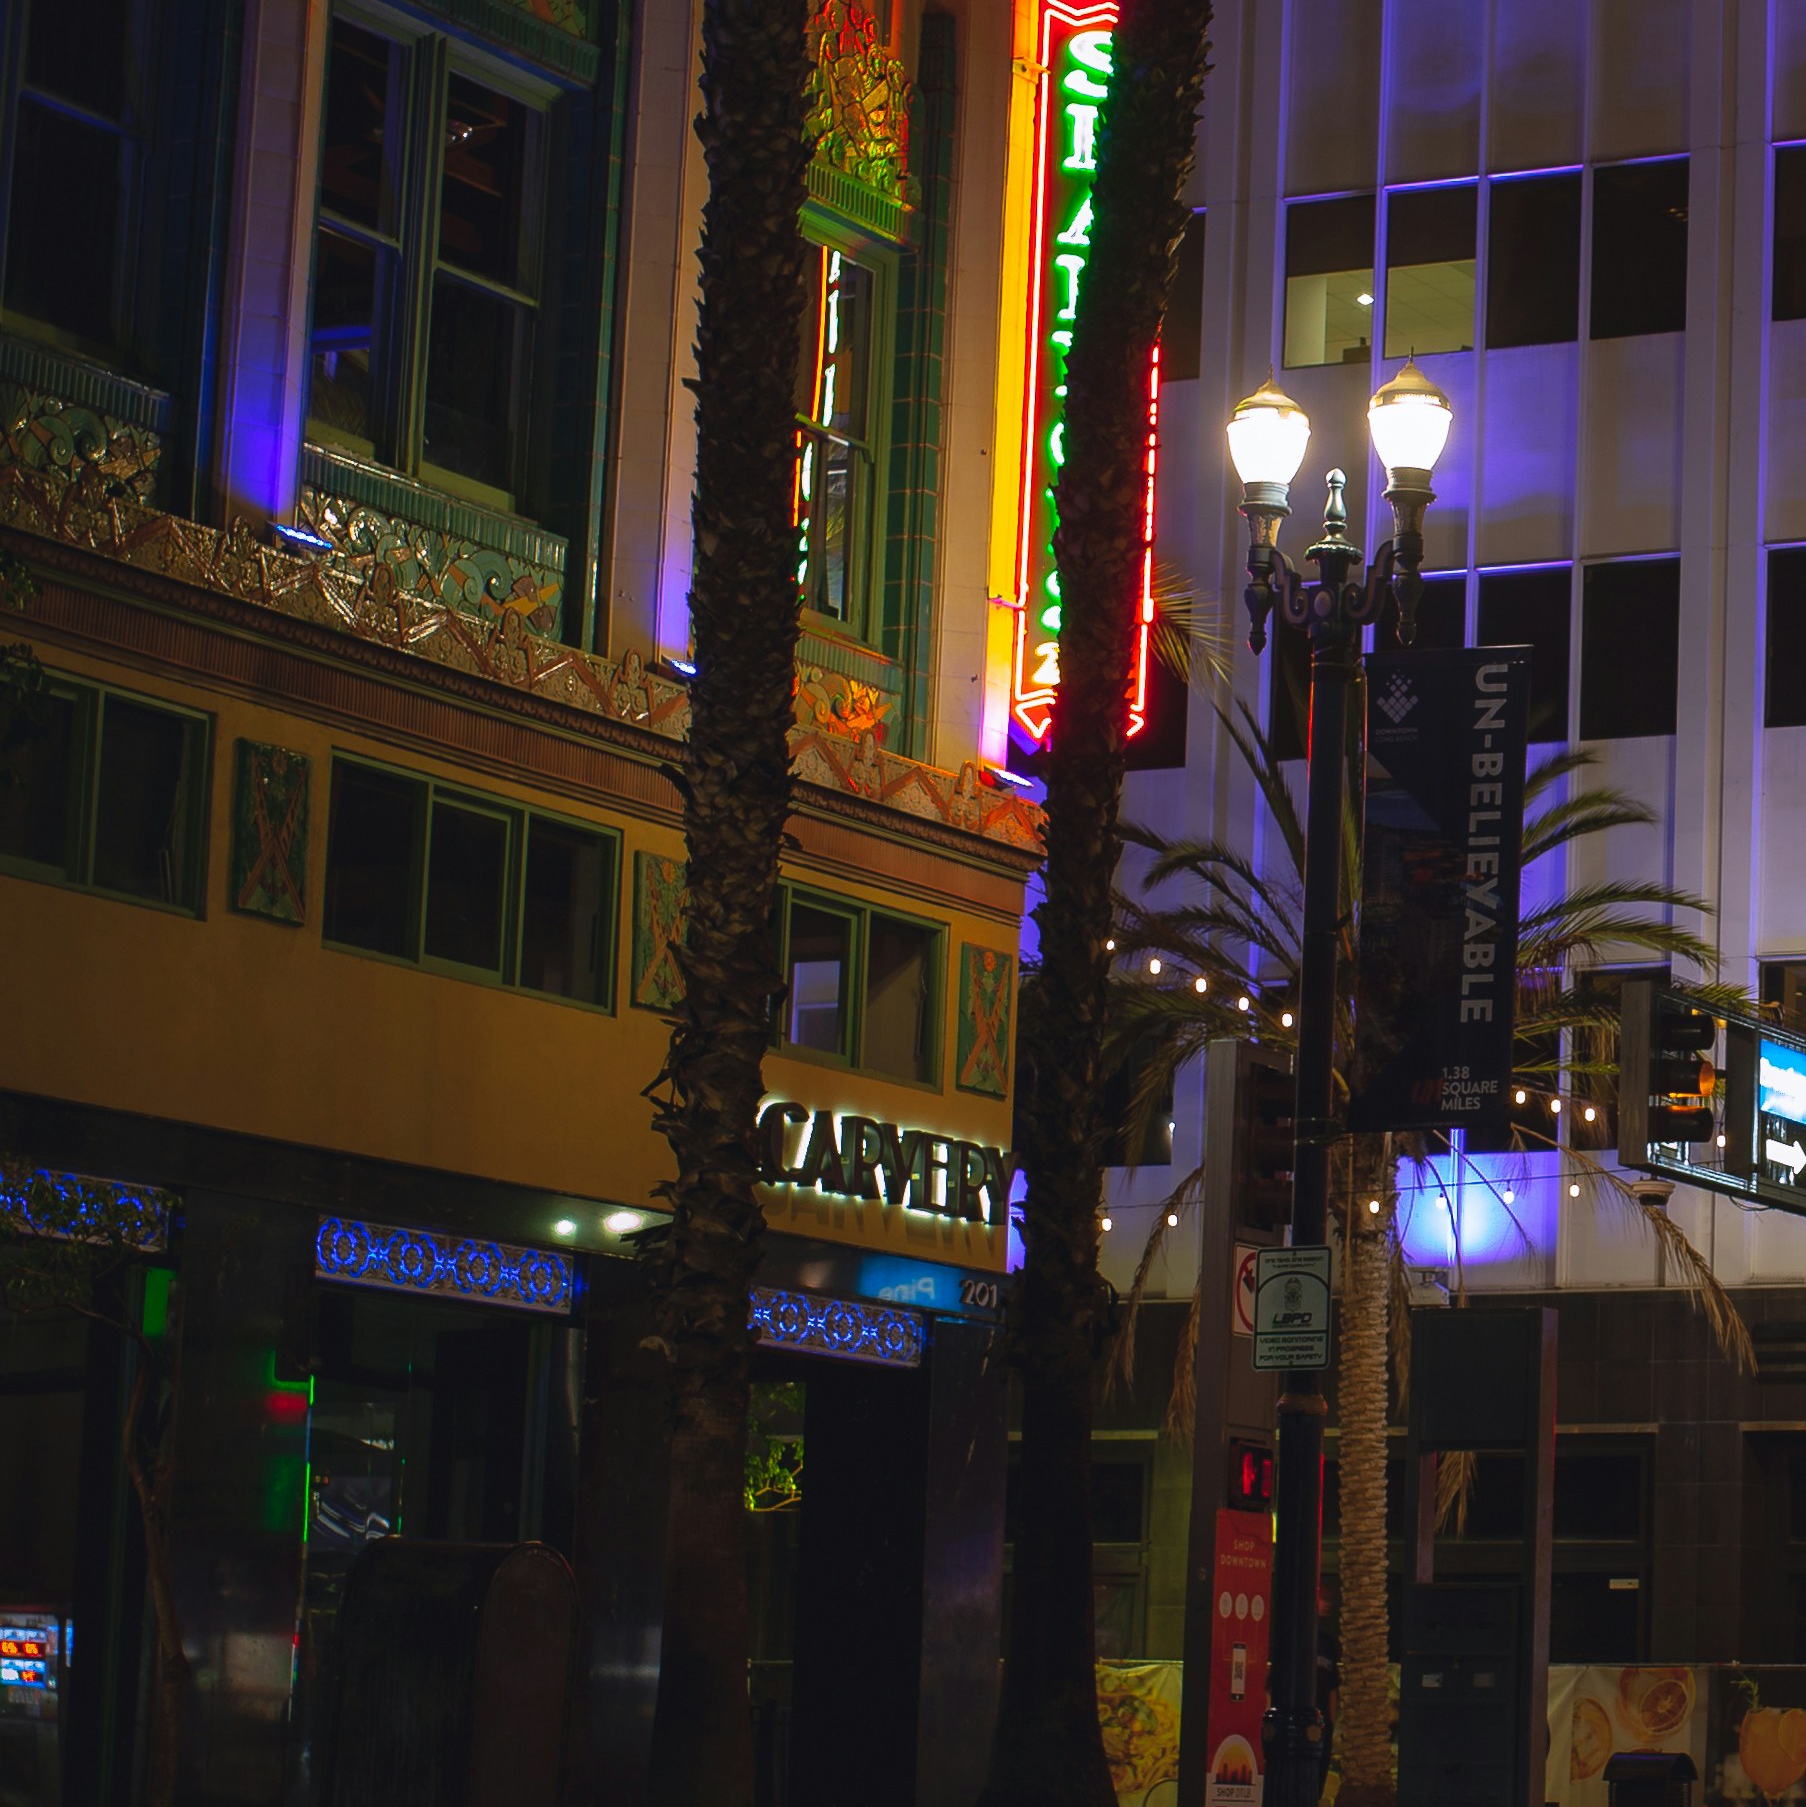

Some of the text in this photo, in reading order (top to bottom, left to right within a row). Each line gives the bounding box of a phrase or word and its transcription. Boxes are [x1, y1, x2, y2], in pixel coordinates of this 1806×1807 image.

[1460, 663, 1509, 1023] UN-BELIEVABLE
[1442, 1066, 1471, 1079] 1.38
[1441, 1080, 1498, 1097] SQUARE
[1441, 1097, 1481, 1111] MILES
[758, 1101, 1022, 1226] CARVERY
[960, 1280, 998, 1308] 201
[1272, 1312, 1312, 1324] LBPD
[1233, 1538, 1255, 1553] SHOP
[1220, 1554, 1267, 1570] DOWNTOWN
[1216, 1787, 1234, 1798] SHOP
